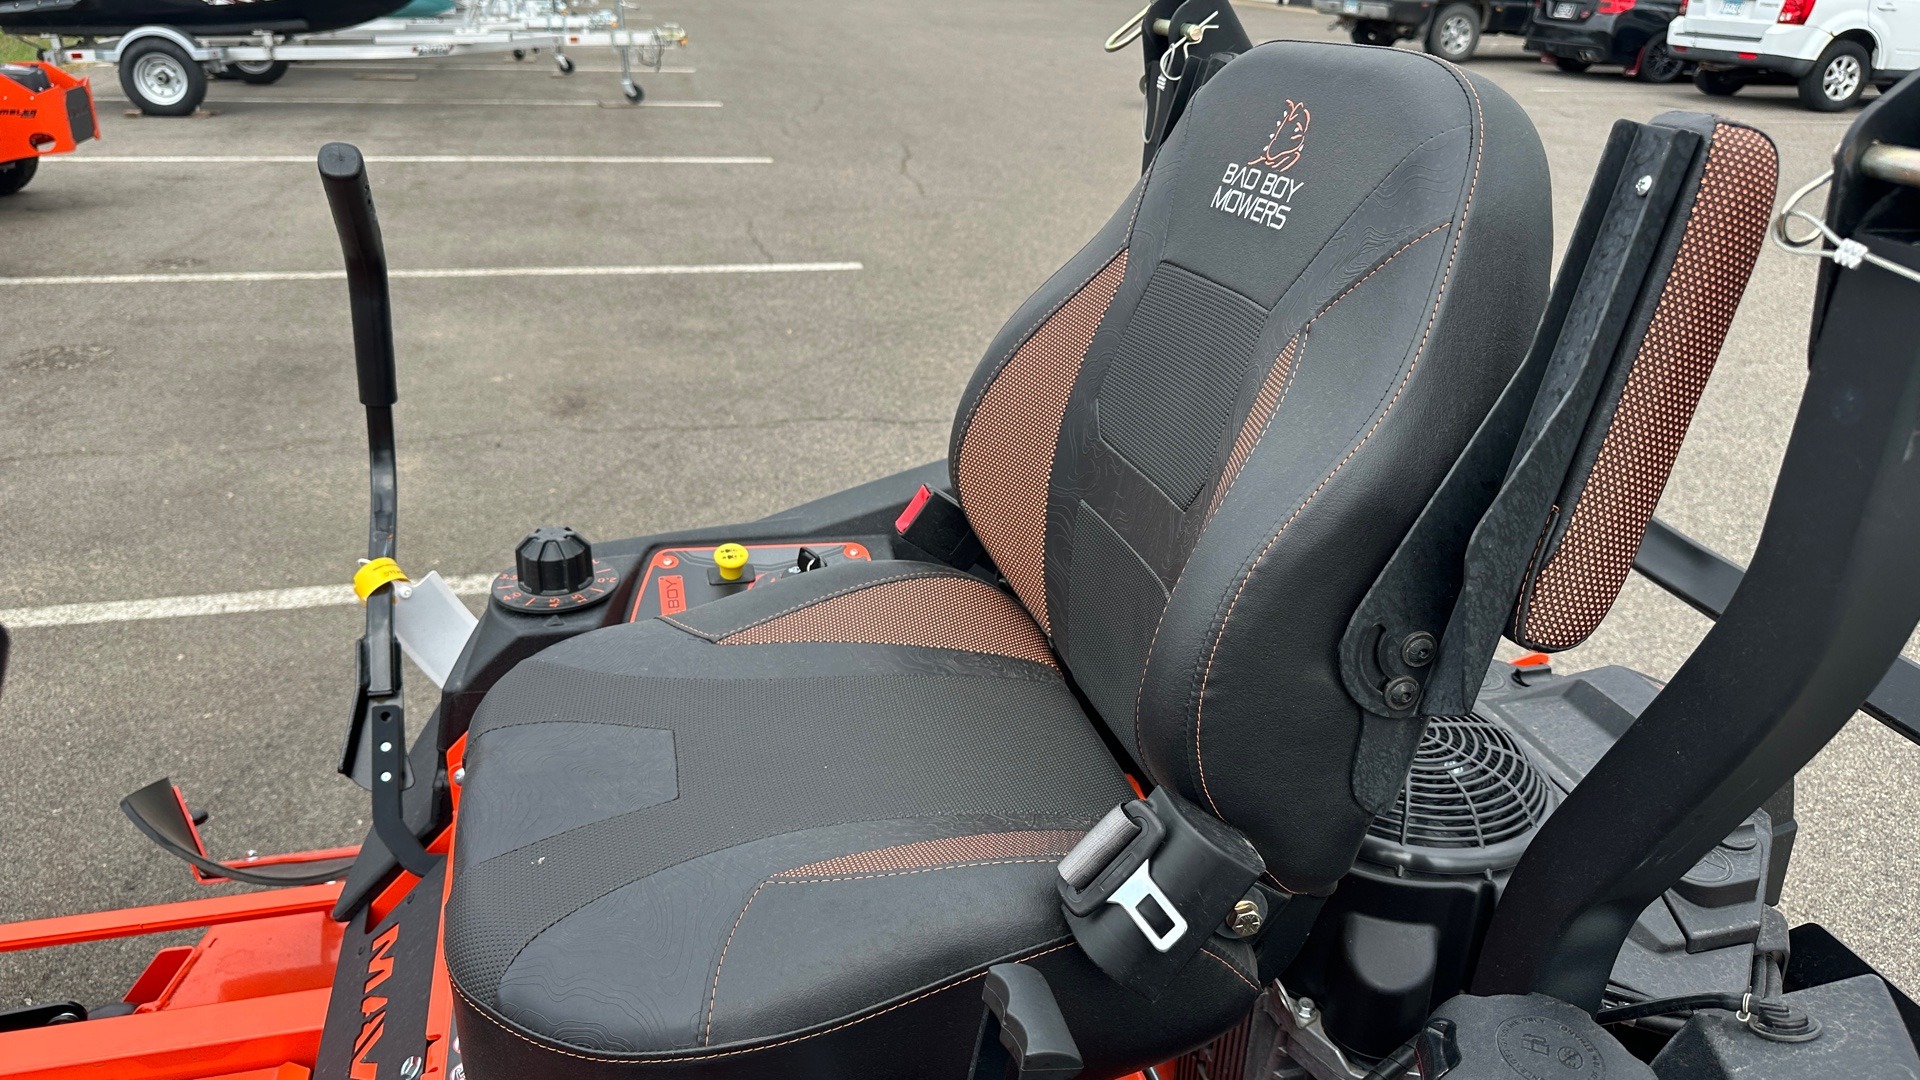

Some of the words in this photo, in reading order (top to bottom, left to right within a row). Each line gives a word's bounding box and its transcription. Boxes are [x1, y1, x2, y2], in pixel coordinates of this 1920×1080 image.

[1222, 163, 1261, 191] BAD
[1260, 172, 1304, 203] BOY
[1210, 185, 1292, 230] MOWERS
[665, 579, 680, 609] BOY
